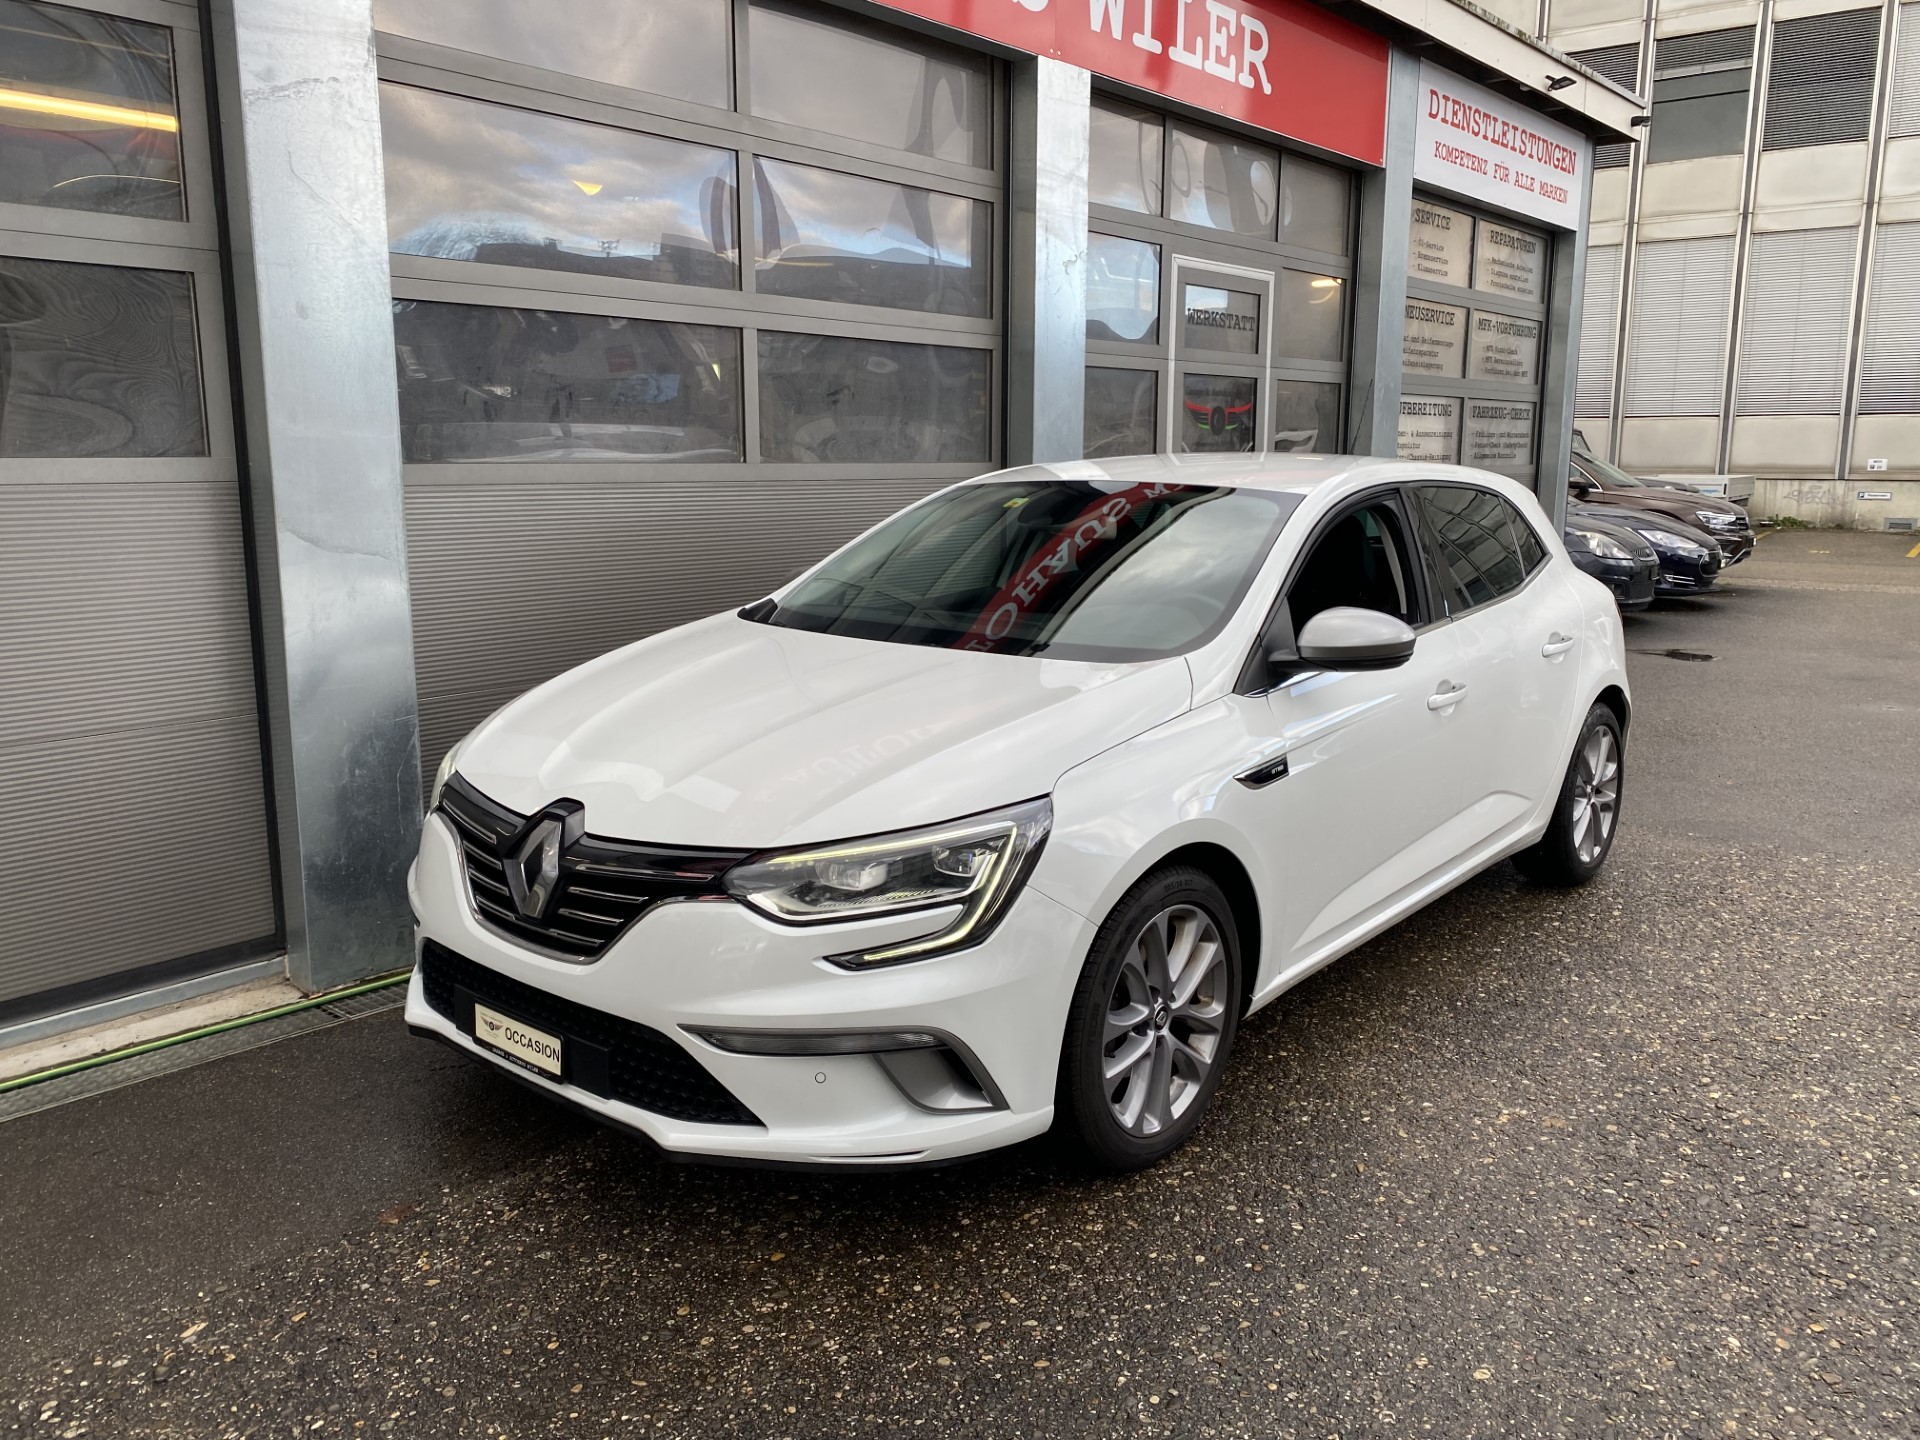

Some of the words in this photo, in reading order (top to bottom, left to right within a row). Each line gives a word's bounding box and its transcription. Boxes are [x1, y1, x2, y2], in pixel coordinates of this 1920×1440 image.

[1088, 0, 1272, 95] WILER
[1428, 89, 1577, 176] DIENSTLEISTUNGEN
[1434, 141, 1489, 175] KOMPETENZ
[1493, 160, 1510, 184] FÜR
[1514, 171, 1535, 192] ALLE
[1539, 180, 1568, 205] MARKEN
[1415, 208, 1451, 230] SERVICE
[1490, 230, 1536, 254] REPARATUREN
[1187, 307, 1255, 332] WERKSTATT
[1405, 305, 1455, 326] NEUSERVICE
[1472, 406, 1531, 420] FAHRZEUG-CHECK
[505, 1027, 560, 1063] OCCASION
